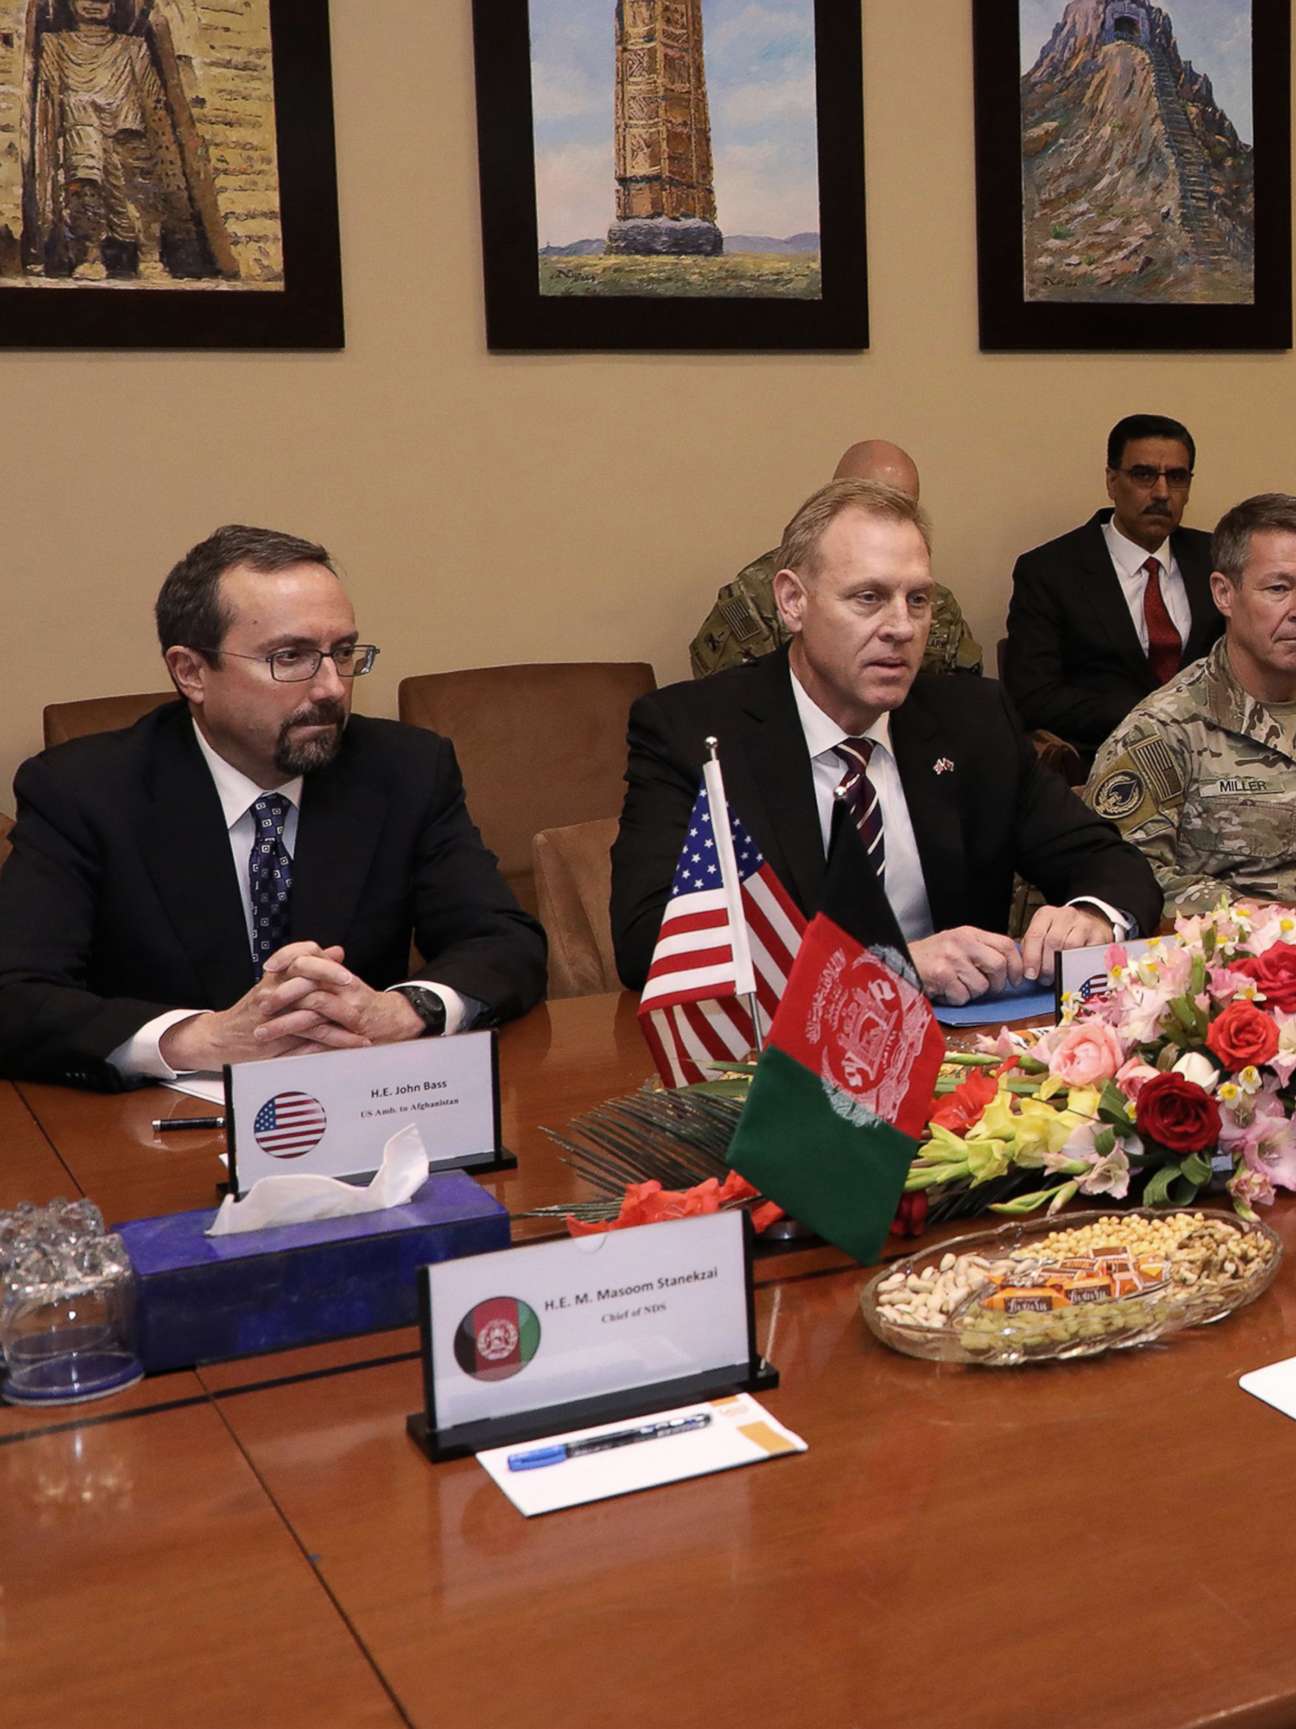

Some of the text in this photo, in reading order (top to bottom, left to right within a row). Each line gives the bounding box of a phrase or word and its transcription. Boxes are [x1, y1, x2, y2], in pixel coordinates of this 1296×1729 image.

[1220, 780, 1267, 792] MILLER
[371, 1080, 447, 1098] H.E. John Bass
[360, 1110, 373, 1118] US
[375, 1106, 396, 1117] Amb.
[410, 1097, 459, 1112] Afghanistan
[544, 1266, 718, 1312] H.E. M. Masoom Stanekzai
[601, 1303, 667, 1324] Chief of NDS
